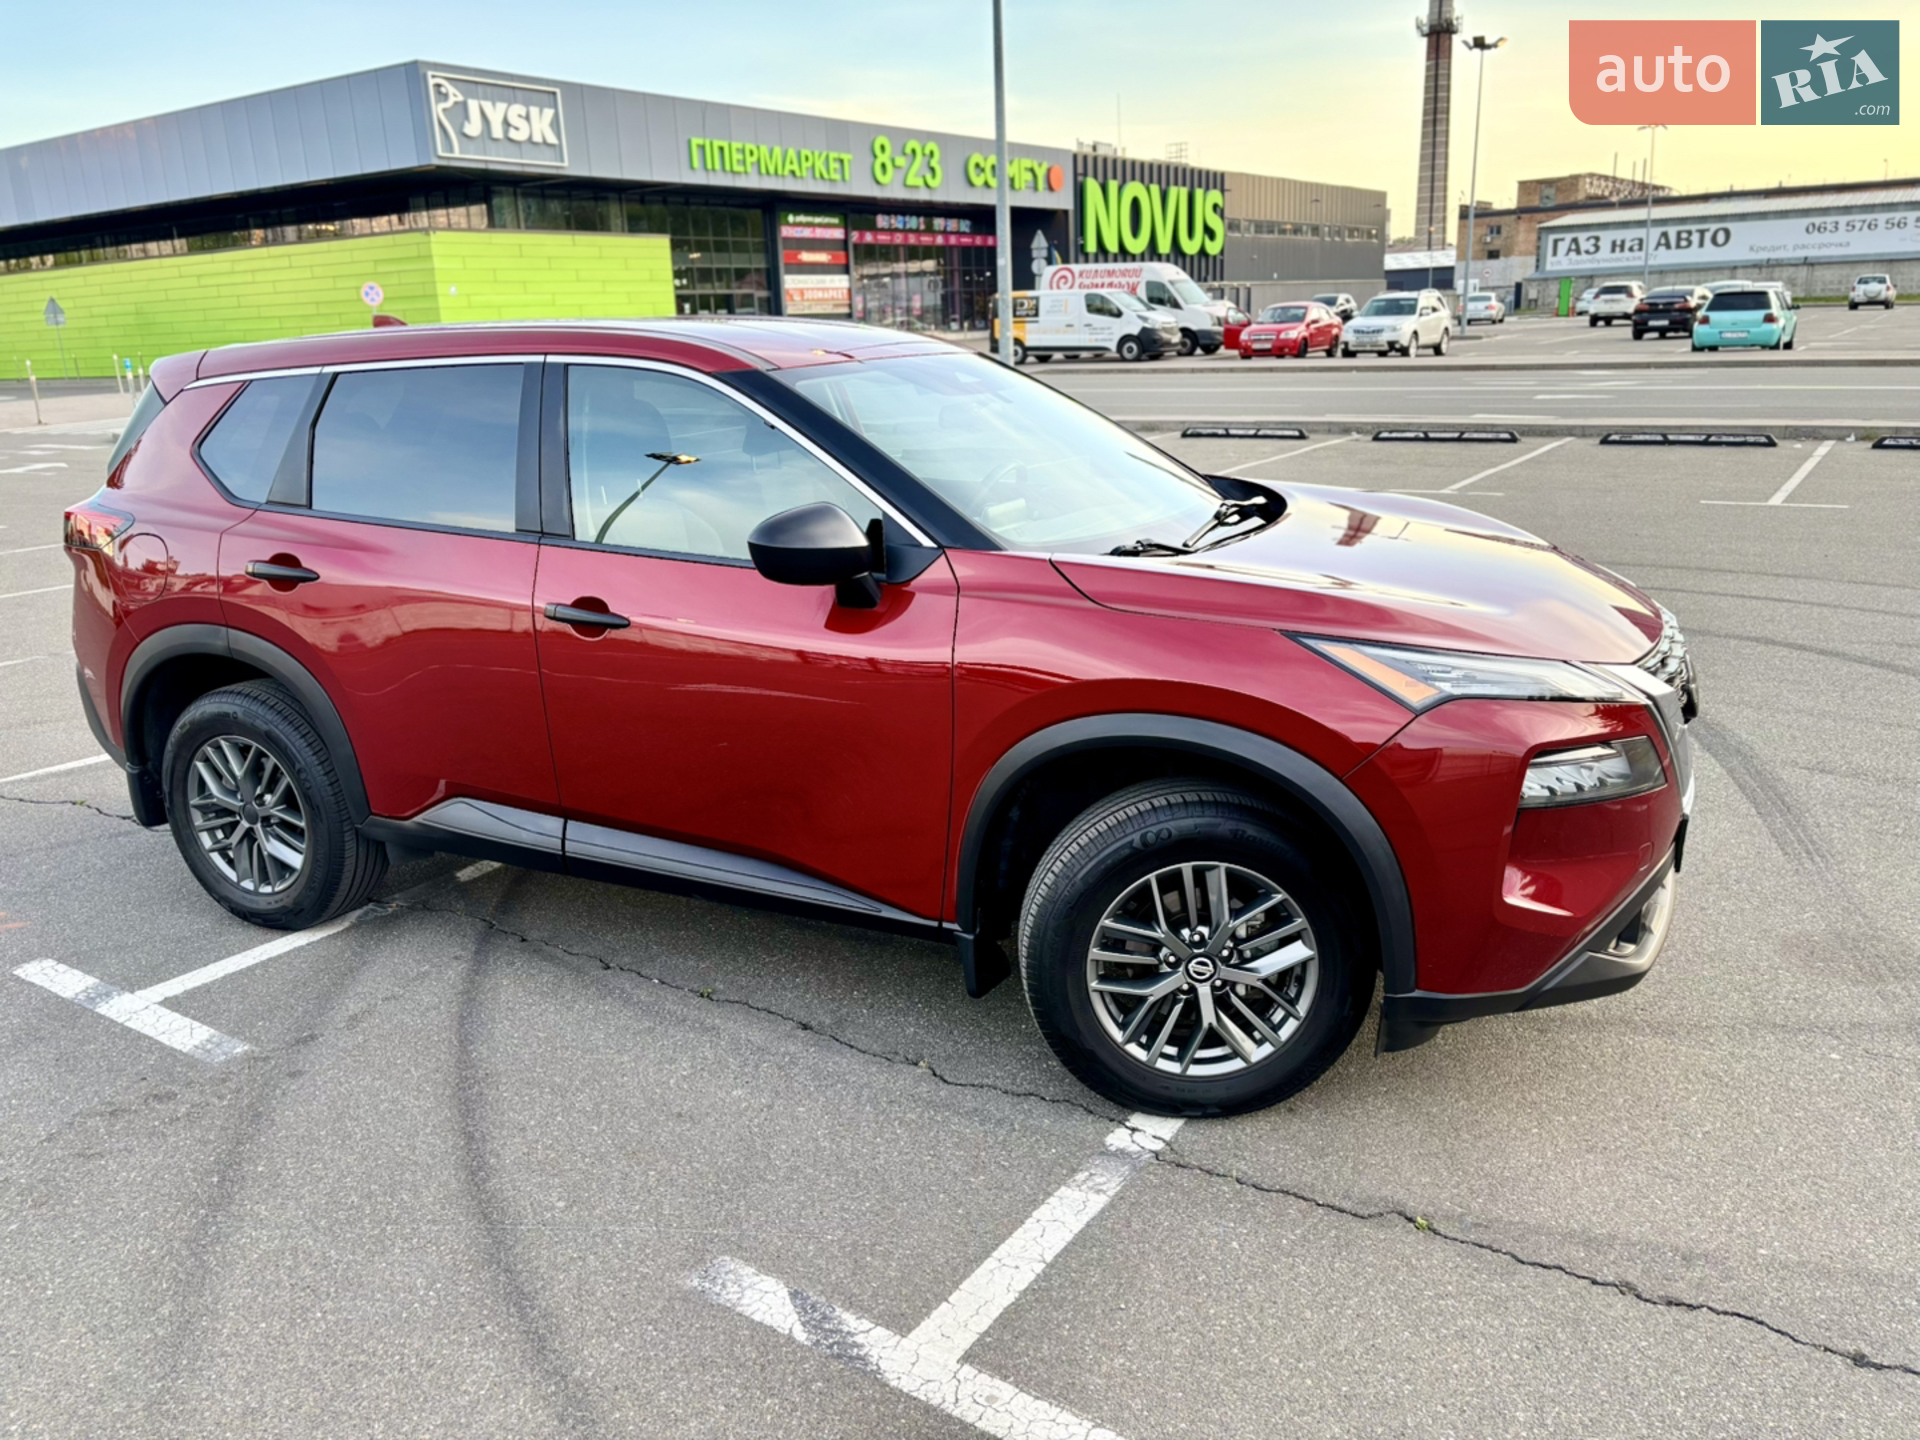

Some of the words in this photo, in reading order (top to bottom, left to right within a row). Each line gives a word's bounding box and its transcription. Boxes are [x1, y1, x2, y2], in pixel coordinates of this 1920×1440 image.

[462, 98, 559, 145] JYSK
[689, 137, 853, 182] ГІПЕРМАРКЕТ
[870, 135, 943, 190] 8-23
[1083, 177, 1225, 257] NOVUS
[1805, 220, 1840, 235] 063
[1845, 217, 1879, 233] 576
[1884, 216, 1908, 231] 56
[1551, 234, 1602, 258] ГАЗ
[1610, 236, 1644, 254] на
[1653, 226, 1732, 252] АВТО
[1792, 240, 1851, 252] рассрочка
